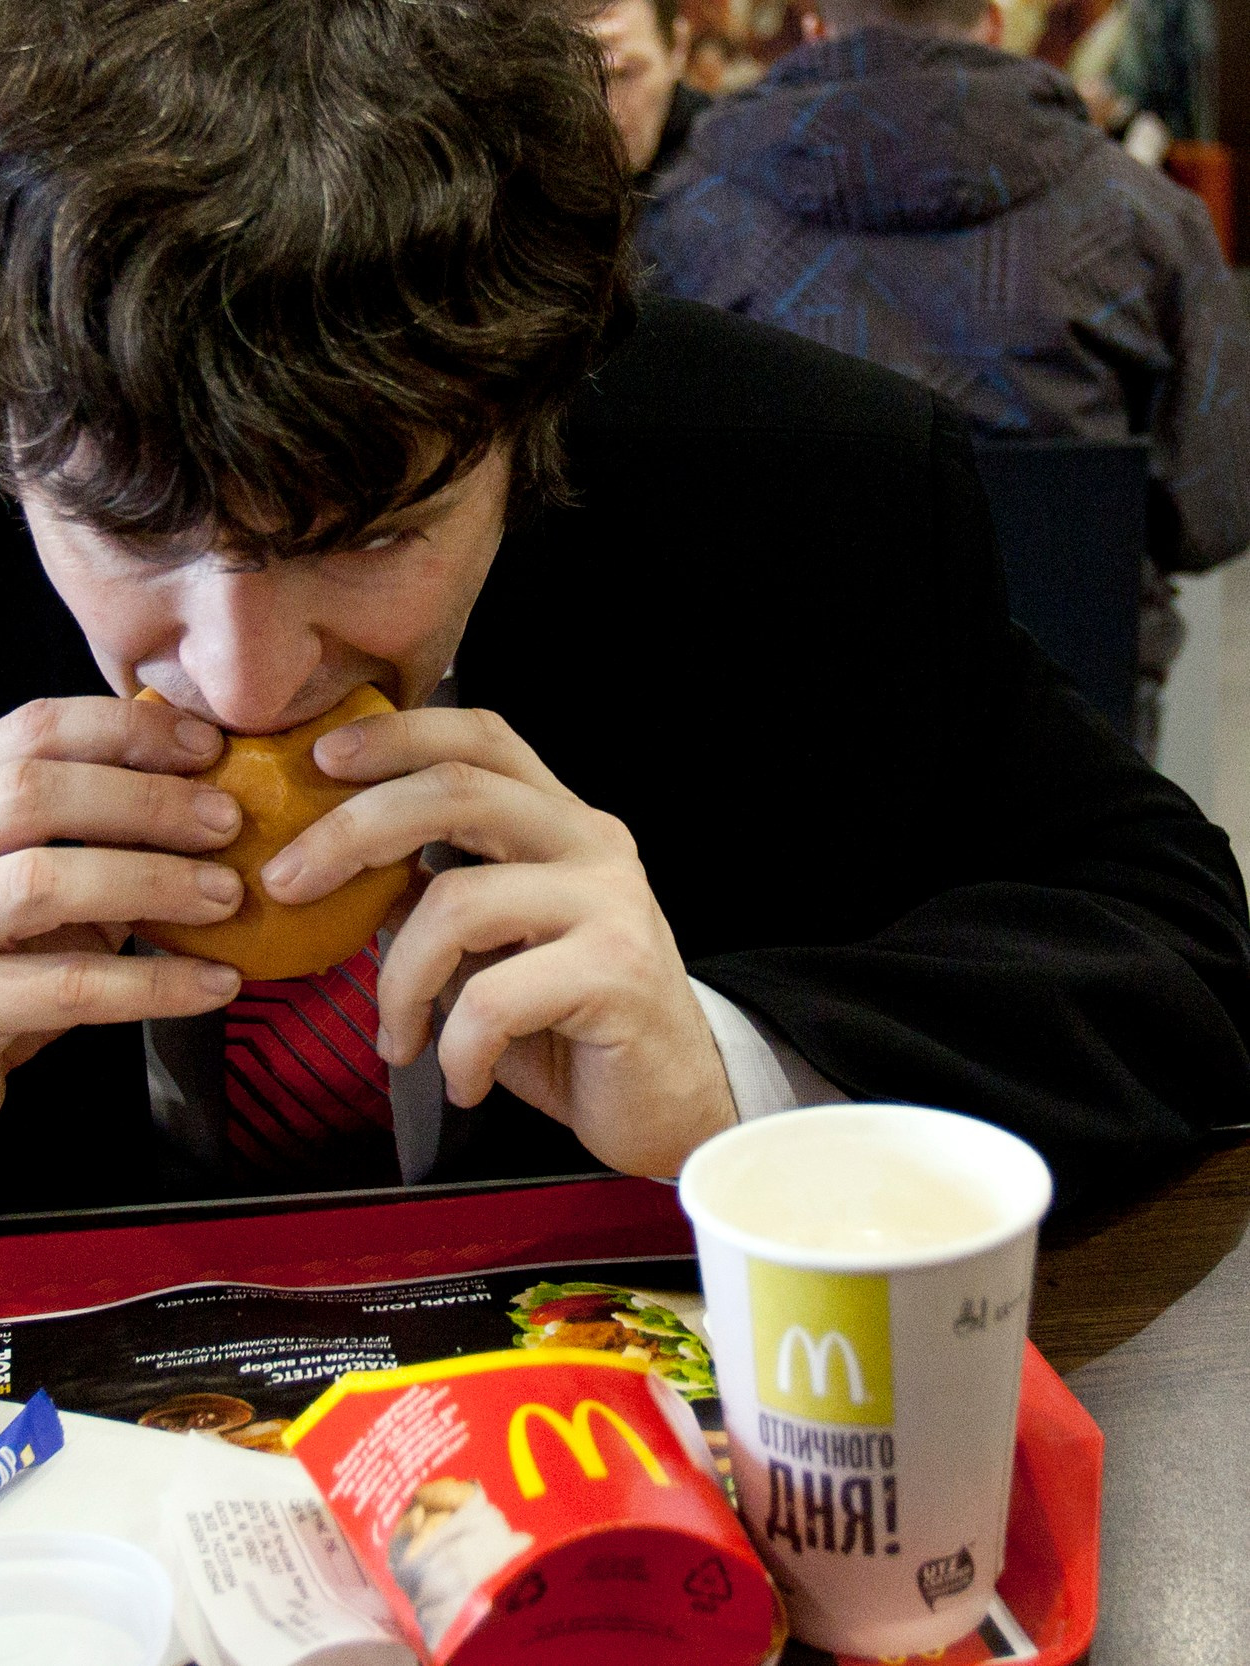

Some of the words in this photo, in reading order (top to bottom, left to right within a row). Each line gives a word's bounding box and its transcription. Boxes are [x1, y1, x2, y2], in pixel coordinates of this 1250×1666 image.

[419, 1292, 492, 1307] ЦЕЗАРЬ
[361, 1301, 417, 1313] РОЛЛ
[219, 1337, 295, 1351] ЛАКОМЫМИ
[212, 1353, 222, 1362] И
[225, 1346, 276, 1360] СТАЯМИ
[324, 1351, 385, 1363] соусом
[155, 1353, 210, 1370] ДЕЛЯТСЯ
[239, 1358, 296, 1374] выбор
[300, 1355, 322, 1366] на
[757, 1413, 896, 1471] ОТЛИЧНОГО
[765, 1460, 902, 1556] ДНЯ!
